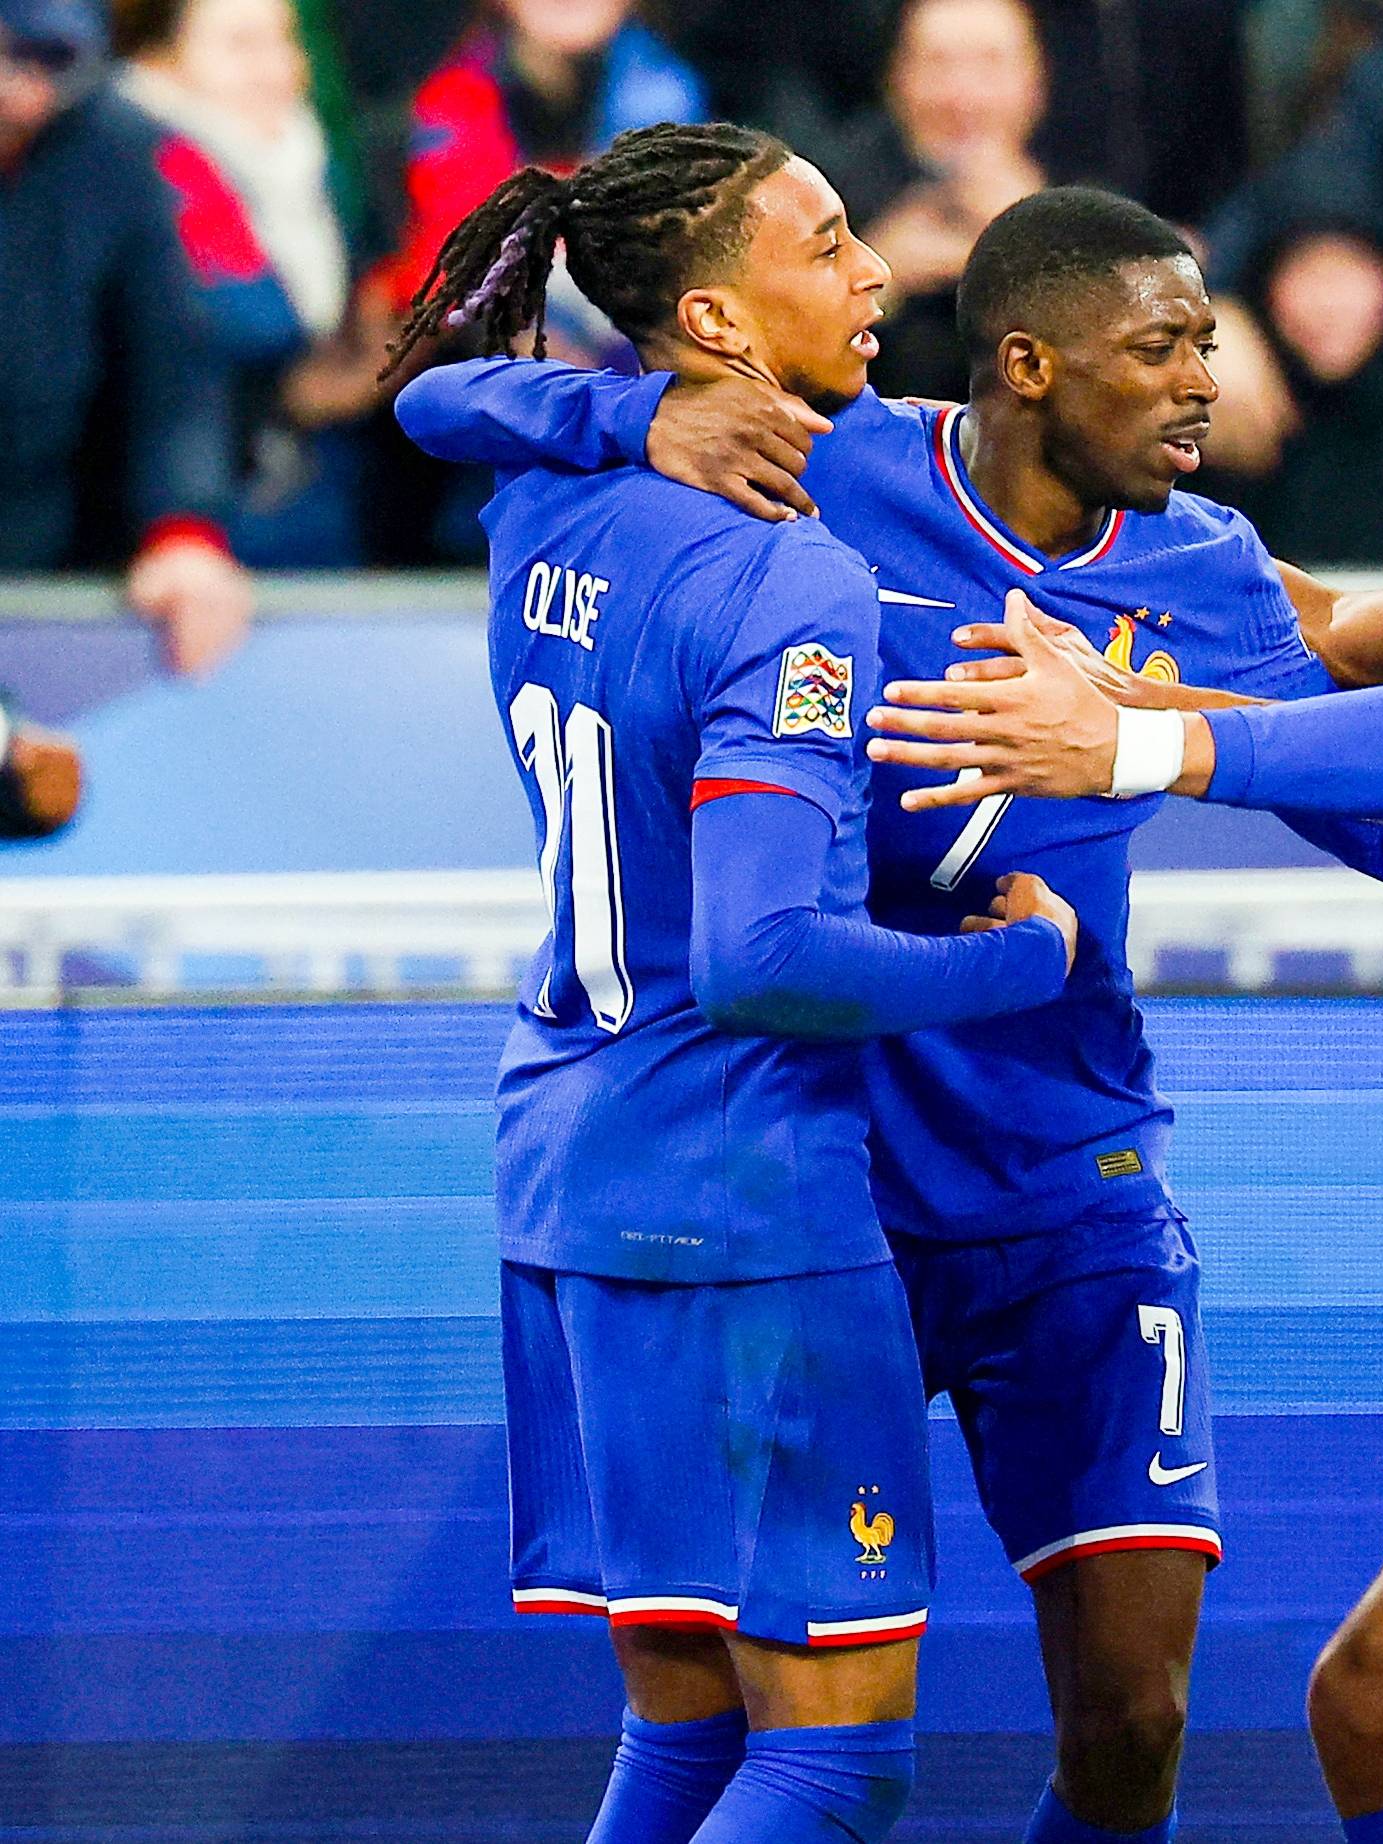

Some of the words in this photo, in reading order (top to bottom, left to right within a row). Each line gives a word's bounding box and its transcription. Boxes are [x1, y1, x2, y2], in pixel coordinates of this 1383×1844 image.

[523, 561, 609, 650] OLISE
[509, 682, 633, 1034] 11
[1138, 1304, 1183, 1435] 7
